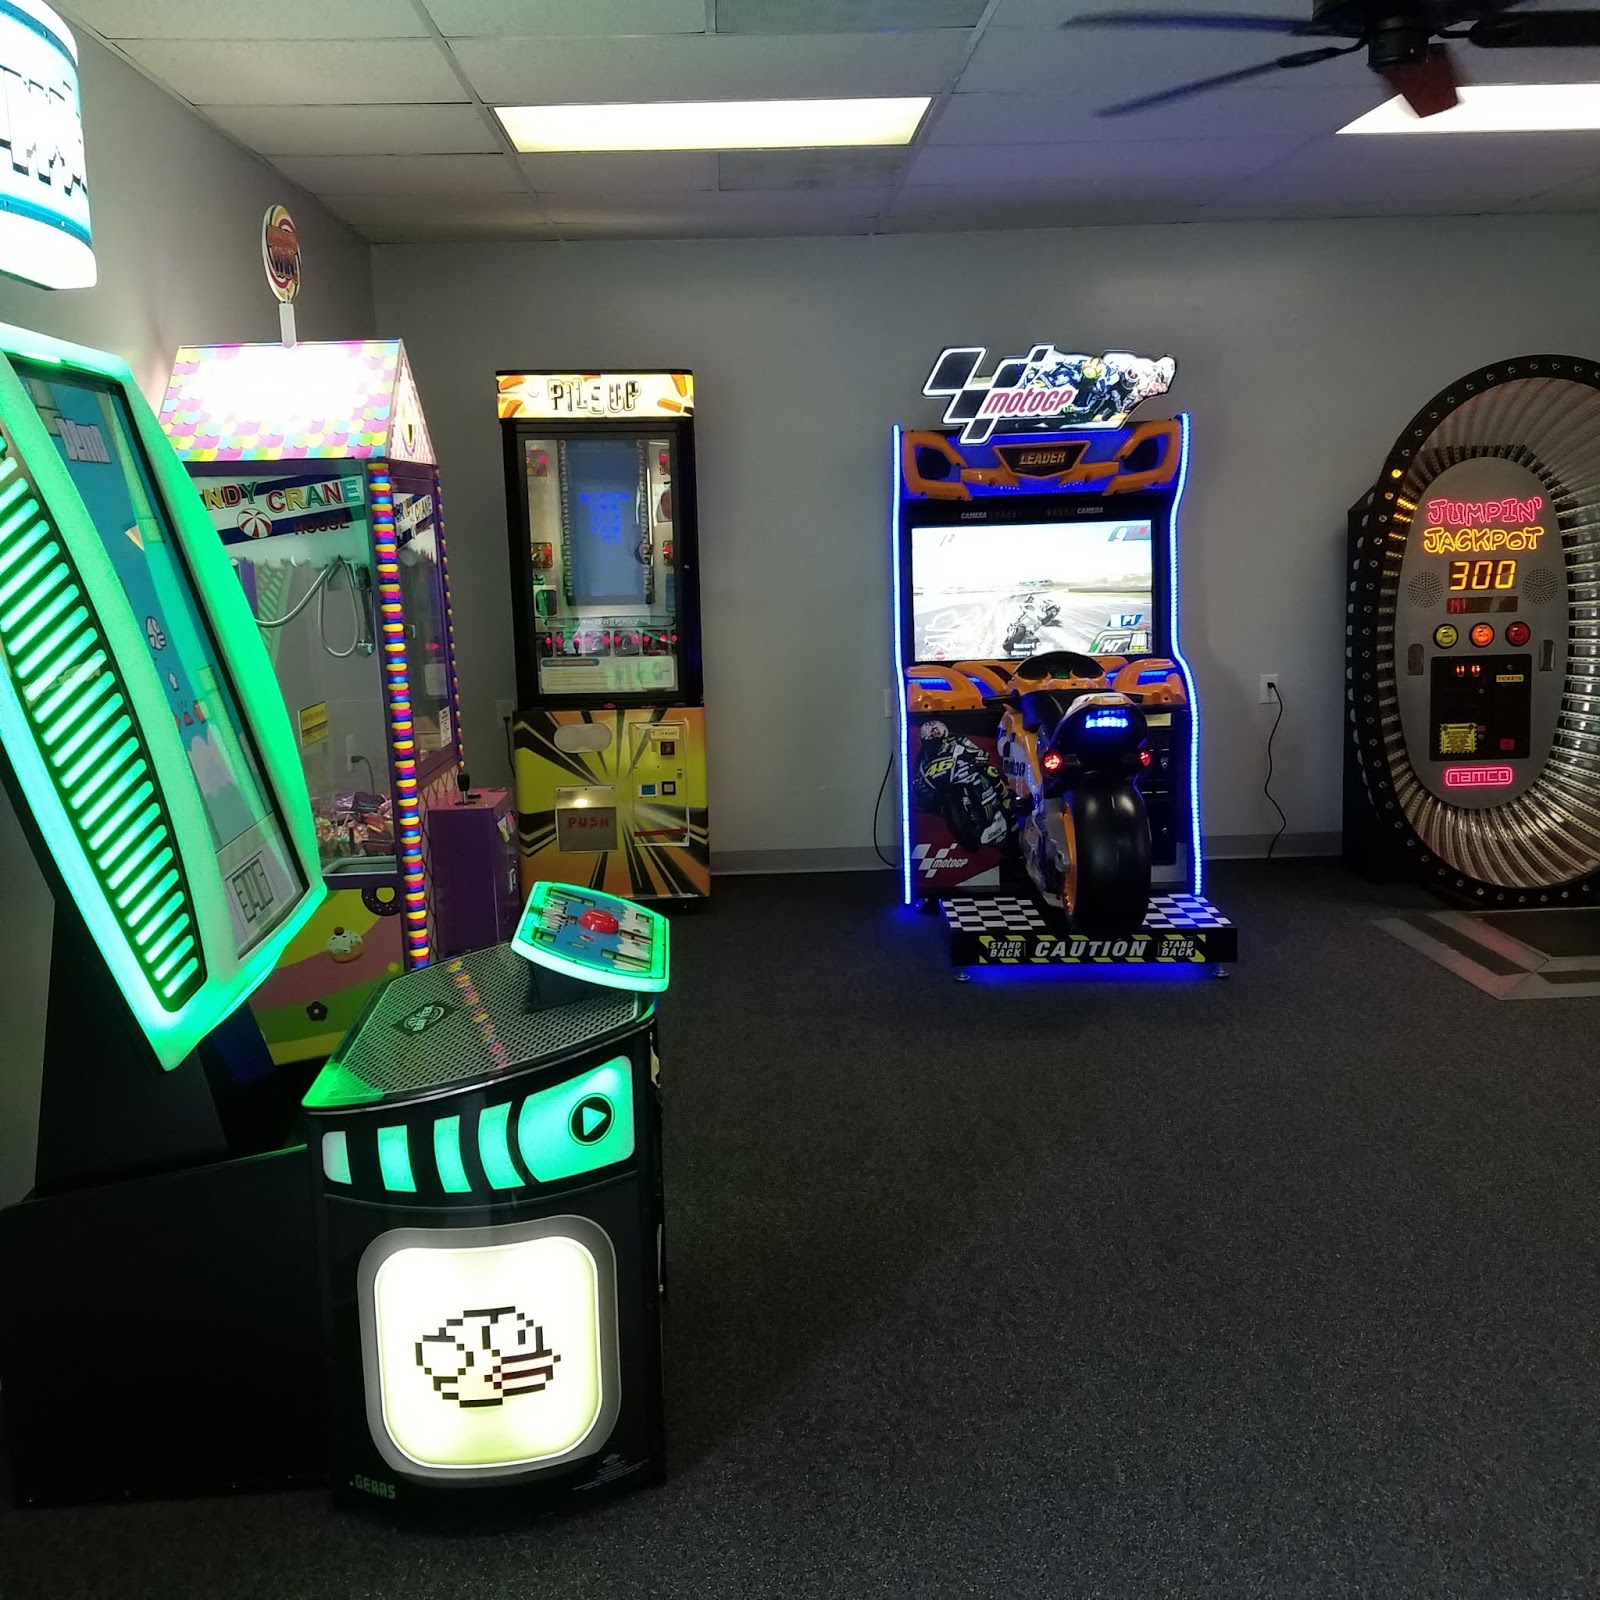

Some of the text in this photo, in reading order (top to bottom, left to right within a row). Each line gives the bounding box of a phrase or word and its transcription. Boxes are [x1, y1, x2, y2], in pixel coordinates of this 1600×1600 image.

[1020, 452, 1066, 465] LEADER
[203, 479, 361, 513] NDY CRANE
[1427, 497, 1542, 526] JUMPIN'
[1423, 526, 1544, 554] JACKPOT
[1449, 560, 1517, 591] 300
[925, 759, 954, 777] 46
[567, 816, 609, 829] PUSH
[989, 941, 1021, 949] STAND
[1034, 941, 1147, 957] CAUTION
[1162, 940, 1194, 948] STAND
[989, 949, 1021, 957] BACK
[1161, 948, 1194, 957] BACK
